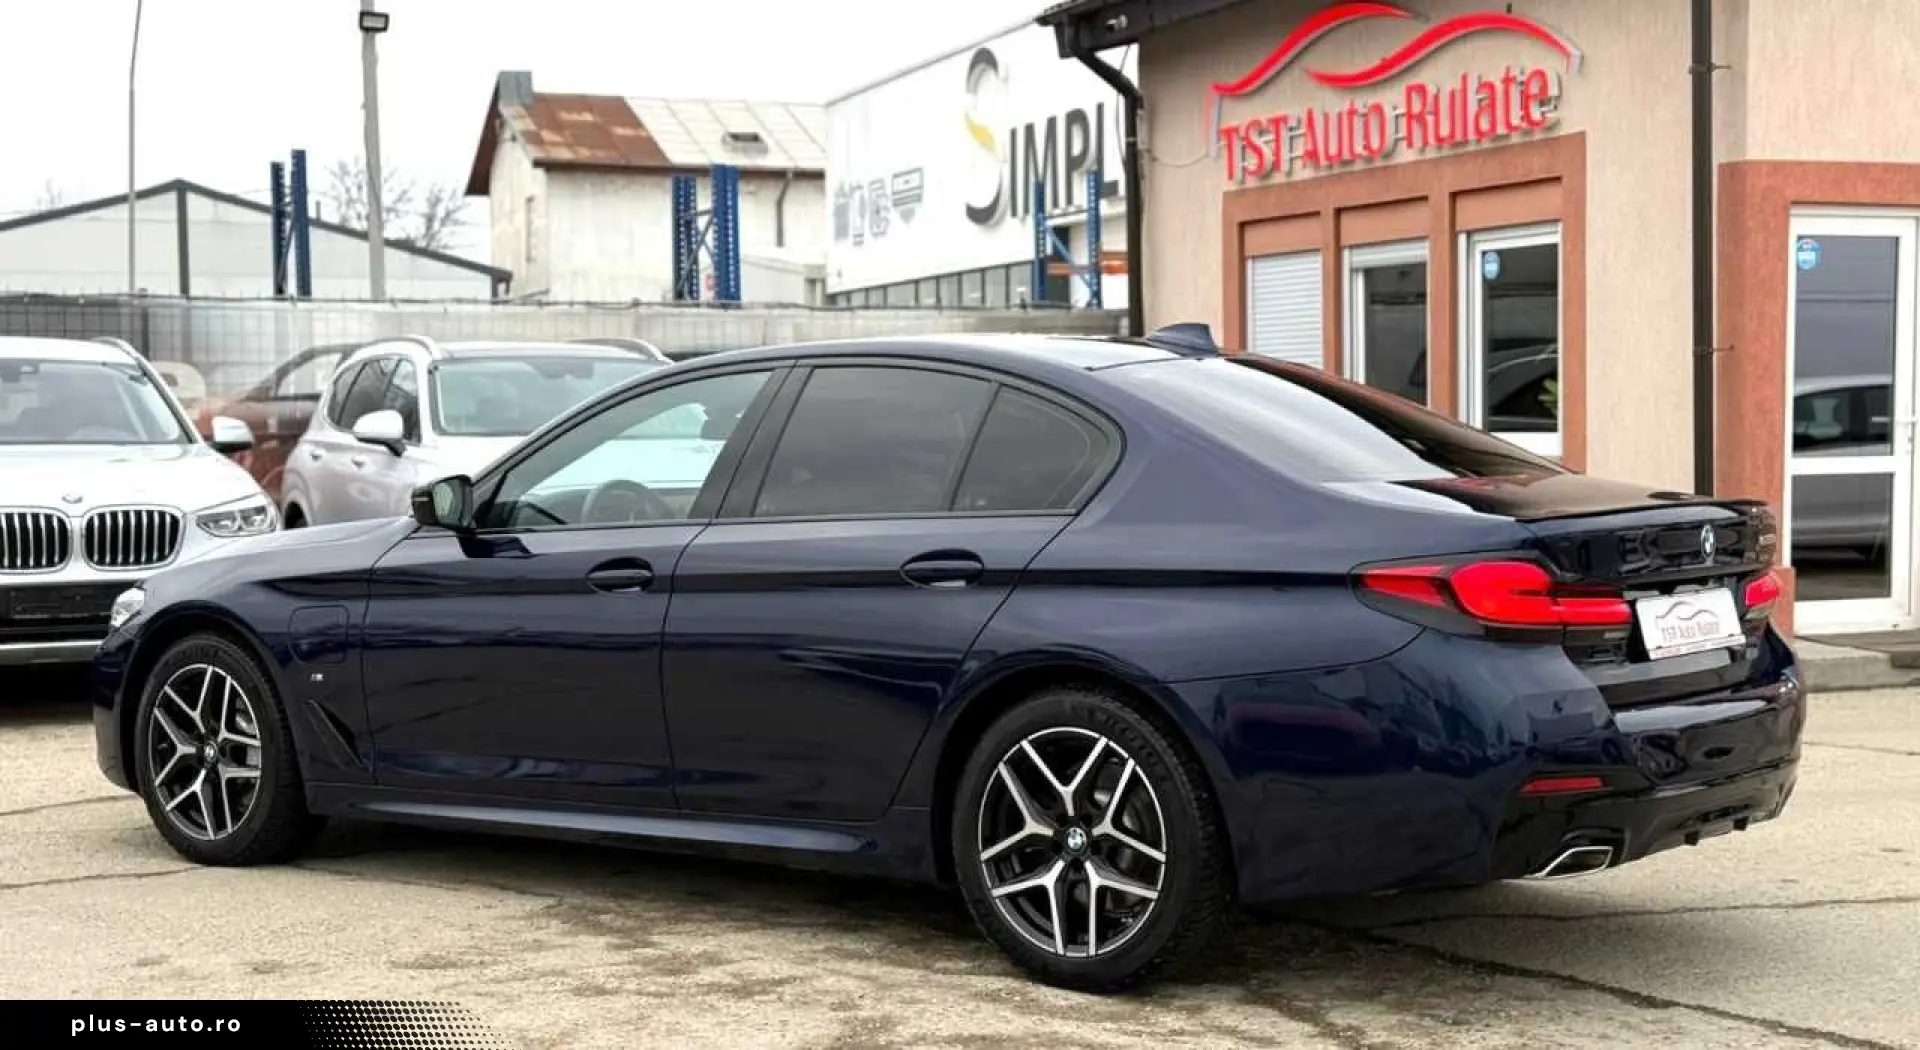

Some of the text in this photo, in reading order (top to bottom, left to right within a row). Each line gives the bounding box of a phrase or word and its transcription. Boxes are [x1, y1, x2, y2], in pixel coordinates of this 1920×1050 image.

[1219, 65, 1557, 181] TST Auto Rulate
